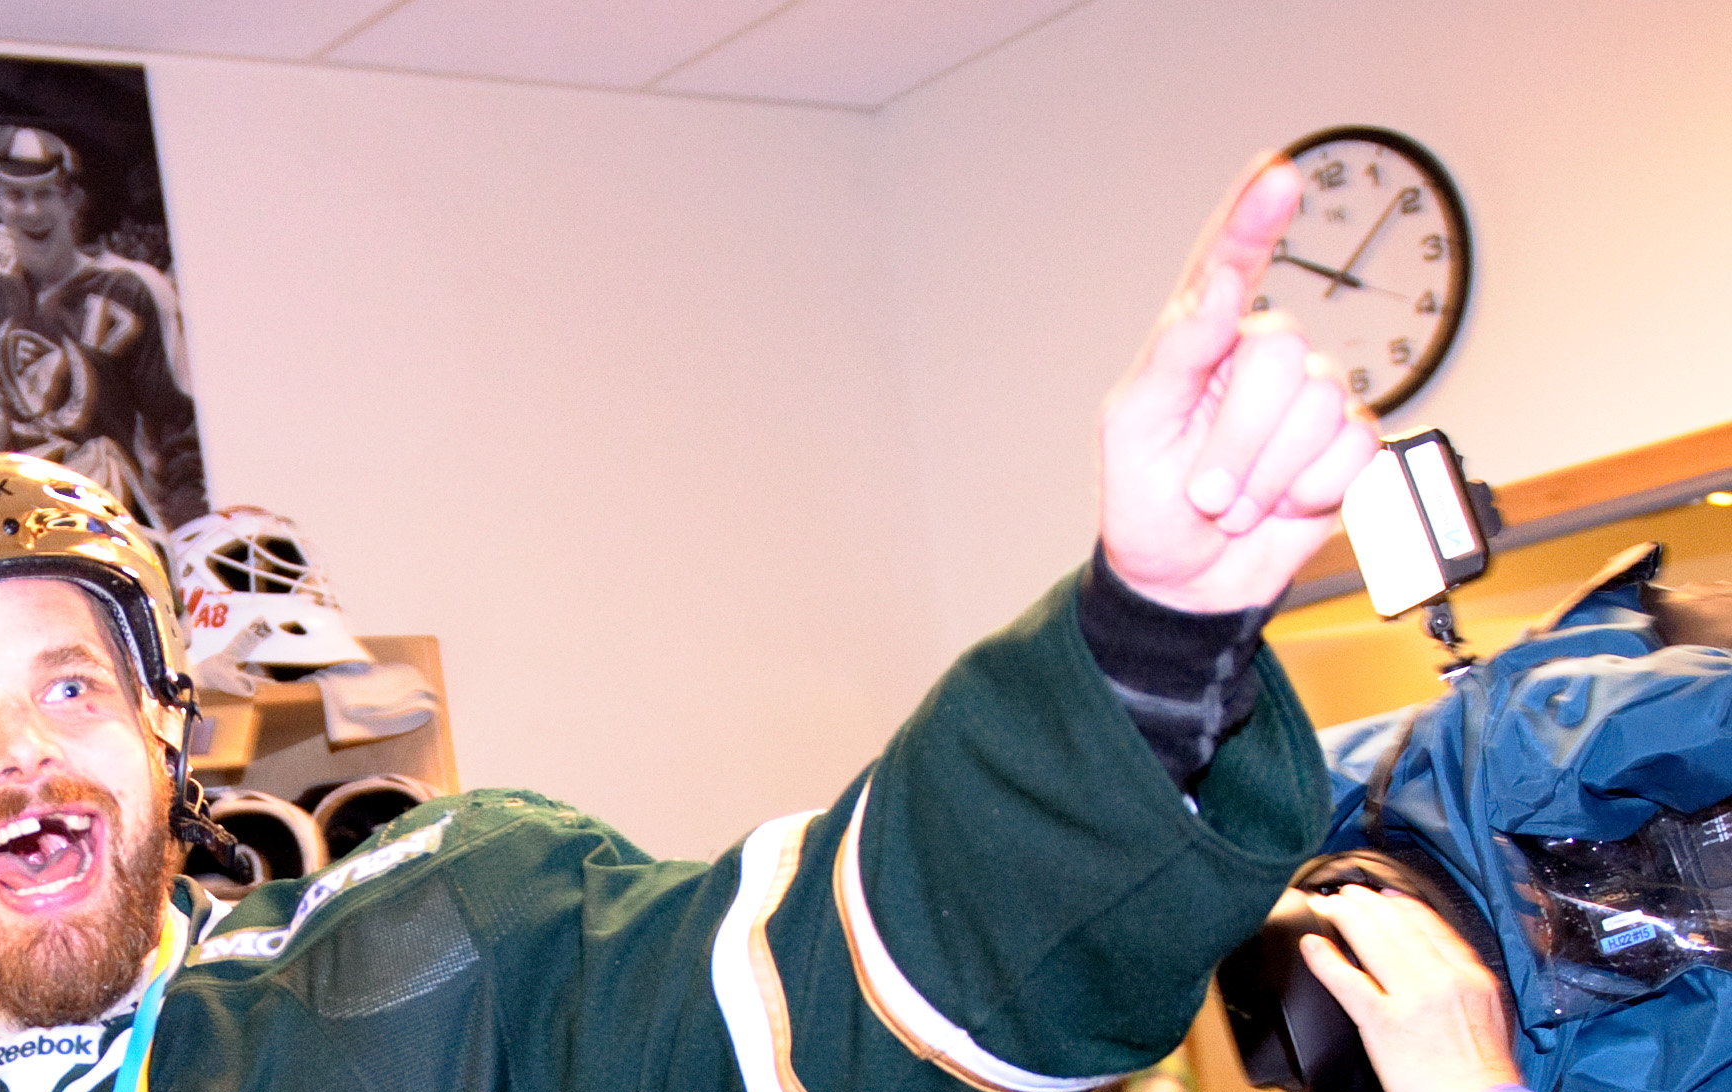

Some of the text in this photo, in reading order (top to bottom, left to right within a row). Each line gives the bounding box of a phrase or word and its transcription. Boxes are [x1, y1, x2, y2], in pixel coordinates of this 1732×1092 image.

[1420, 234, 1445, 261] 3
[1414, 291, 1437, 315] 4
[1389, 339, 1411, 364] 5
[1349, 368, 1370, 393] 6
